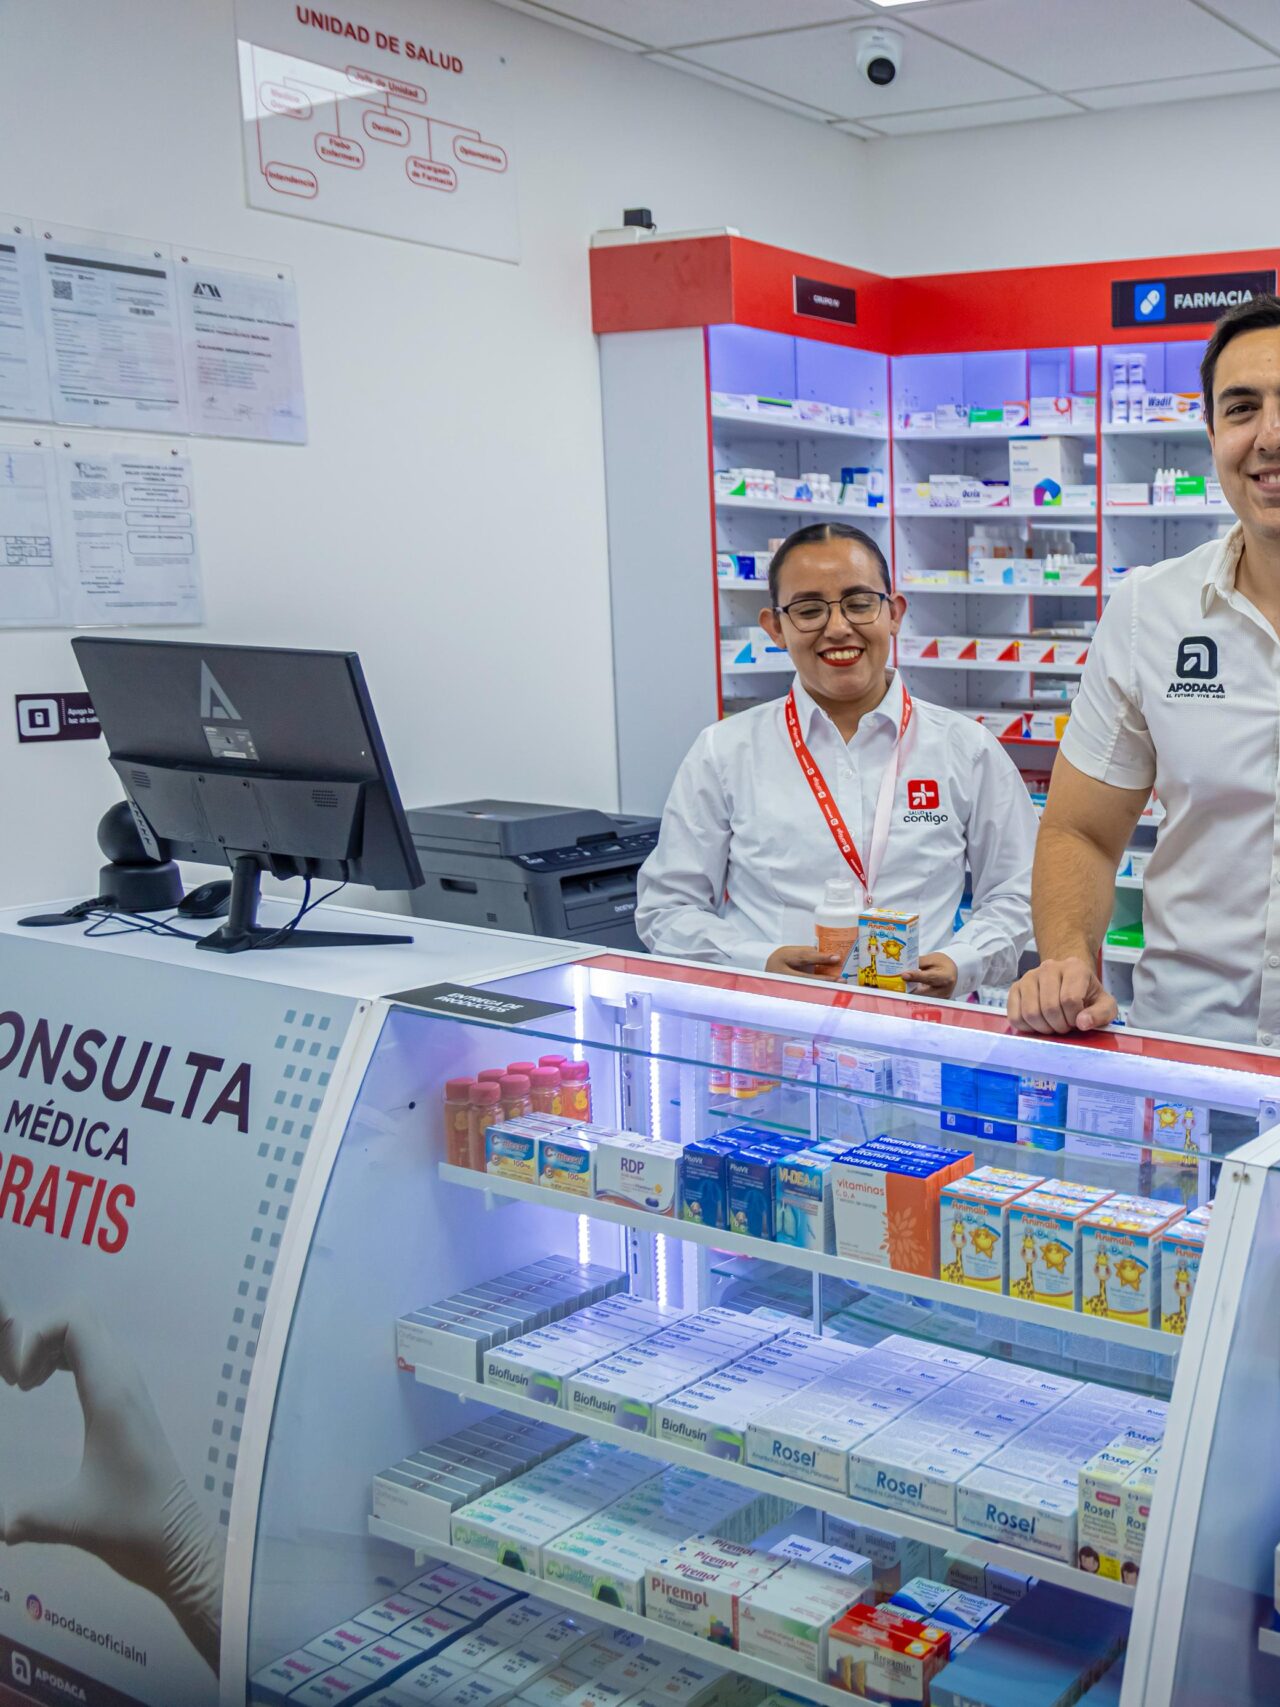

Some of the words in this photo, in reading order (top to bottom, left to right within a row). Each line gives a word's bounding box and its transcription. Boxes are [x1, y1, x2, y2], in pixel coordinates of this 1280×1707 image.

[296, 5, 370, 44] UNIDAD
[376, 32, 400, 54] DE
[406, 42, 464, 73] SALUD
[1174, 290, 1253, 309] FARMACIA
[1168, 683, 1225, 693] APODACA
[904, 812, 948, 825] contigo
[4, 1099, 129, 1166] MÉDICA
[621, 1157, 644, 1174] RDP
[837, 1179, 885, 1196] vitaminas
[0, 1149, 135, 1254] RATIS
[952, 1200, 988, 1216] Animalin
[1021, 1215, 1061, 1231] Animalin
[489, 1364, 528, 1386] Bioflusin
[573, 1391, 616, 1414] Bioflusin
[661, 1418, 706, 1442] Bioflusin
[773, 1440, 816, 1467] Rosel
[877, 1471, 923, 1499] Rosel
[986, 1504, 1035, 1534] Rosel
[1084, 1501, 1115, 1519] Rosel
[675, 1564, 720, 1582] Piremol
[651, 1576, 709, 1607] Piremol
[44, 1607, 147, 1667] apodacaoficialnl
[35, 1667, 87, 1701] APODACA
